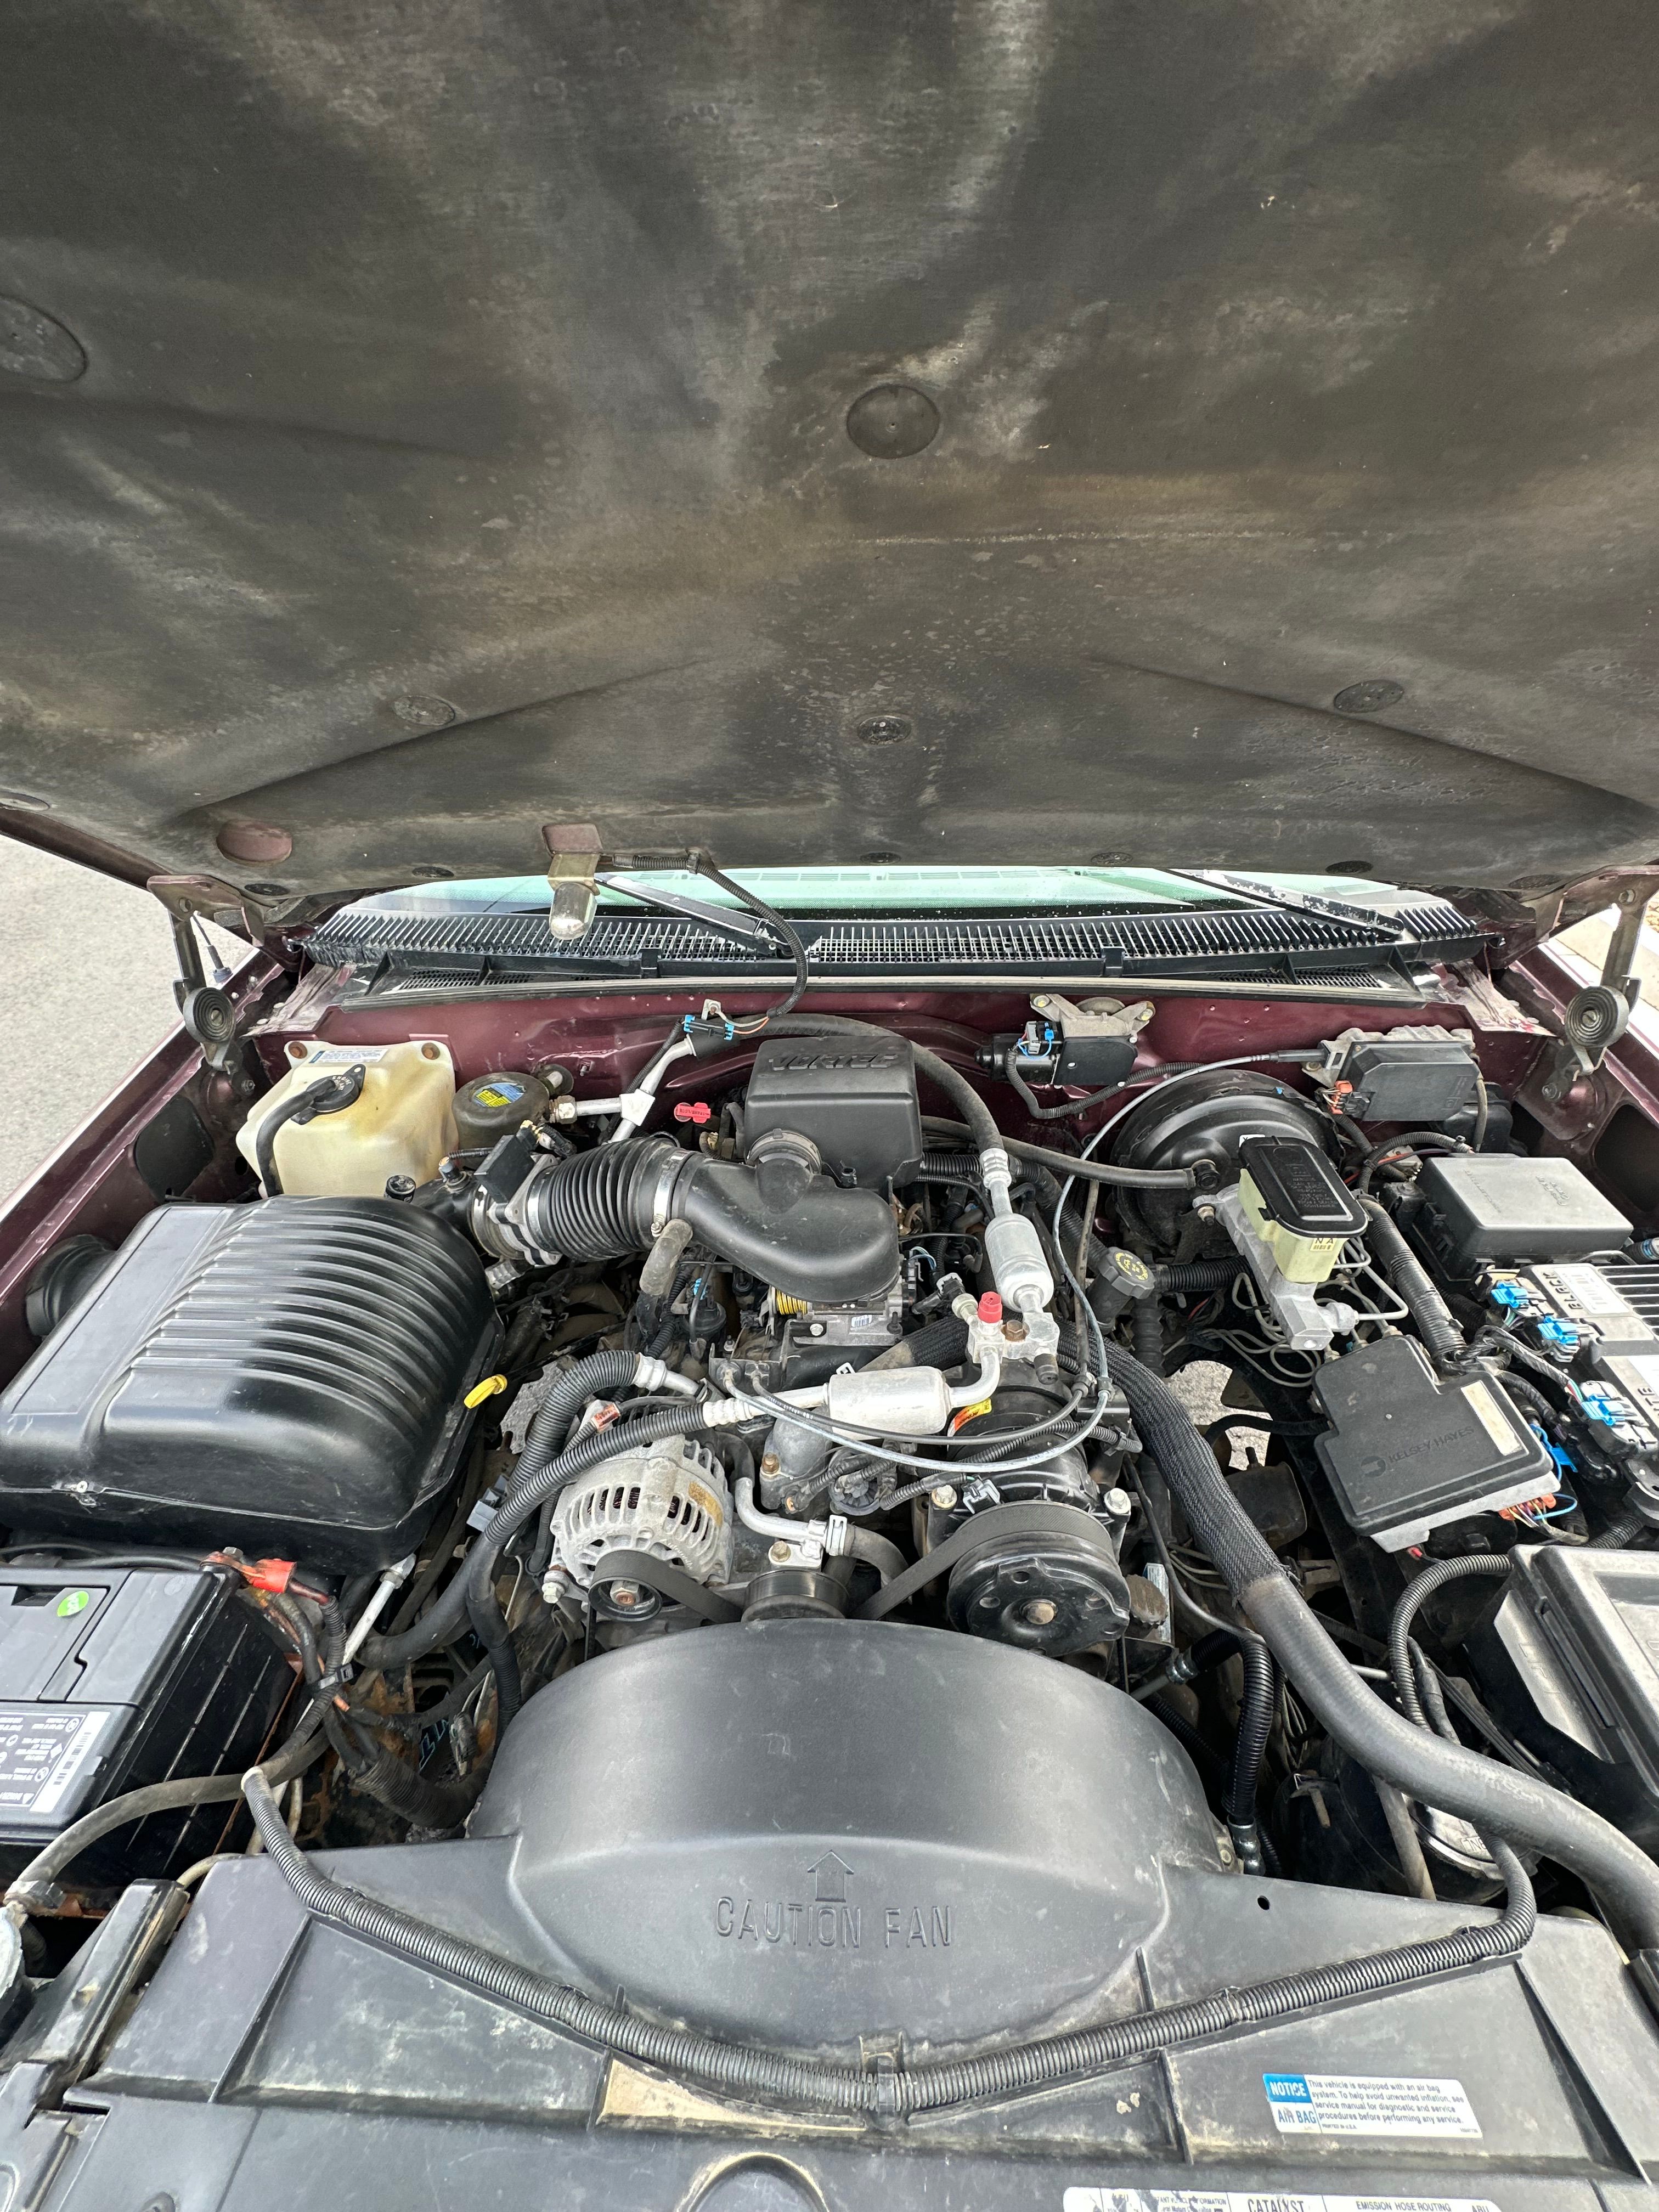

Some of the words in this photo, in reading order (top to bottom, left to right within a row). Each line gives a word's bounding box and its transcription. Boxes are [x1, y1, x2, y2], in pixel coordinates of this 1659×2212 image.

[769, 1053, 898, 1070] VORTEC
[715, 1896, 861, 1949] CAUTION
[884, 1905, 951, 1948] FAN
[1269, 2081, 1307, 2096] NOTICE
[1308, 2080, 1323, 2088] This
[1324, 2080, 1348, 2089] vehicle
[1358, 2082, 1389, 2091] equipped
[1426, 2085, 1441, 2094] bag
[1312, 2091, 1338, 2099] system.
[1349, 2092, 1364, 2100] help
[1341, 2101, 1366, 2110] manual
[1367, 2102, 1377, 2111] for
[1379, 2103, 1415, 2113] diagnostic
[1278, 2109, 1295, 2123] AIR
[1296, 2111, 1317, 2124] BAG
[1358, 2112, 1381, 2121] before
[1383, 2113, 1422, 2125] performing
[1356, 2200, 1392, 2210] EMISSION
[1395, 2202, 1417, 2211] HOSE
[1418, 2202, 1452, 2211] ROUTING
